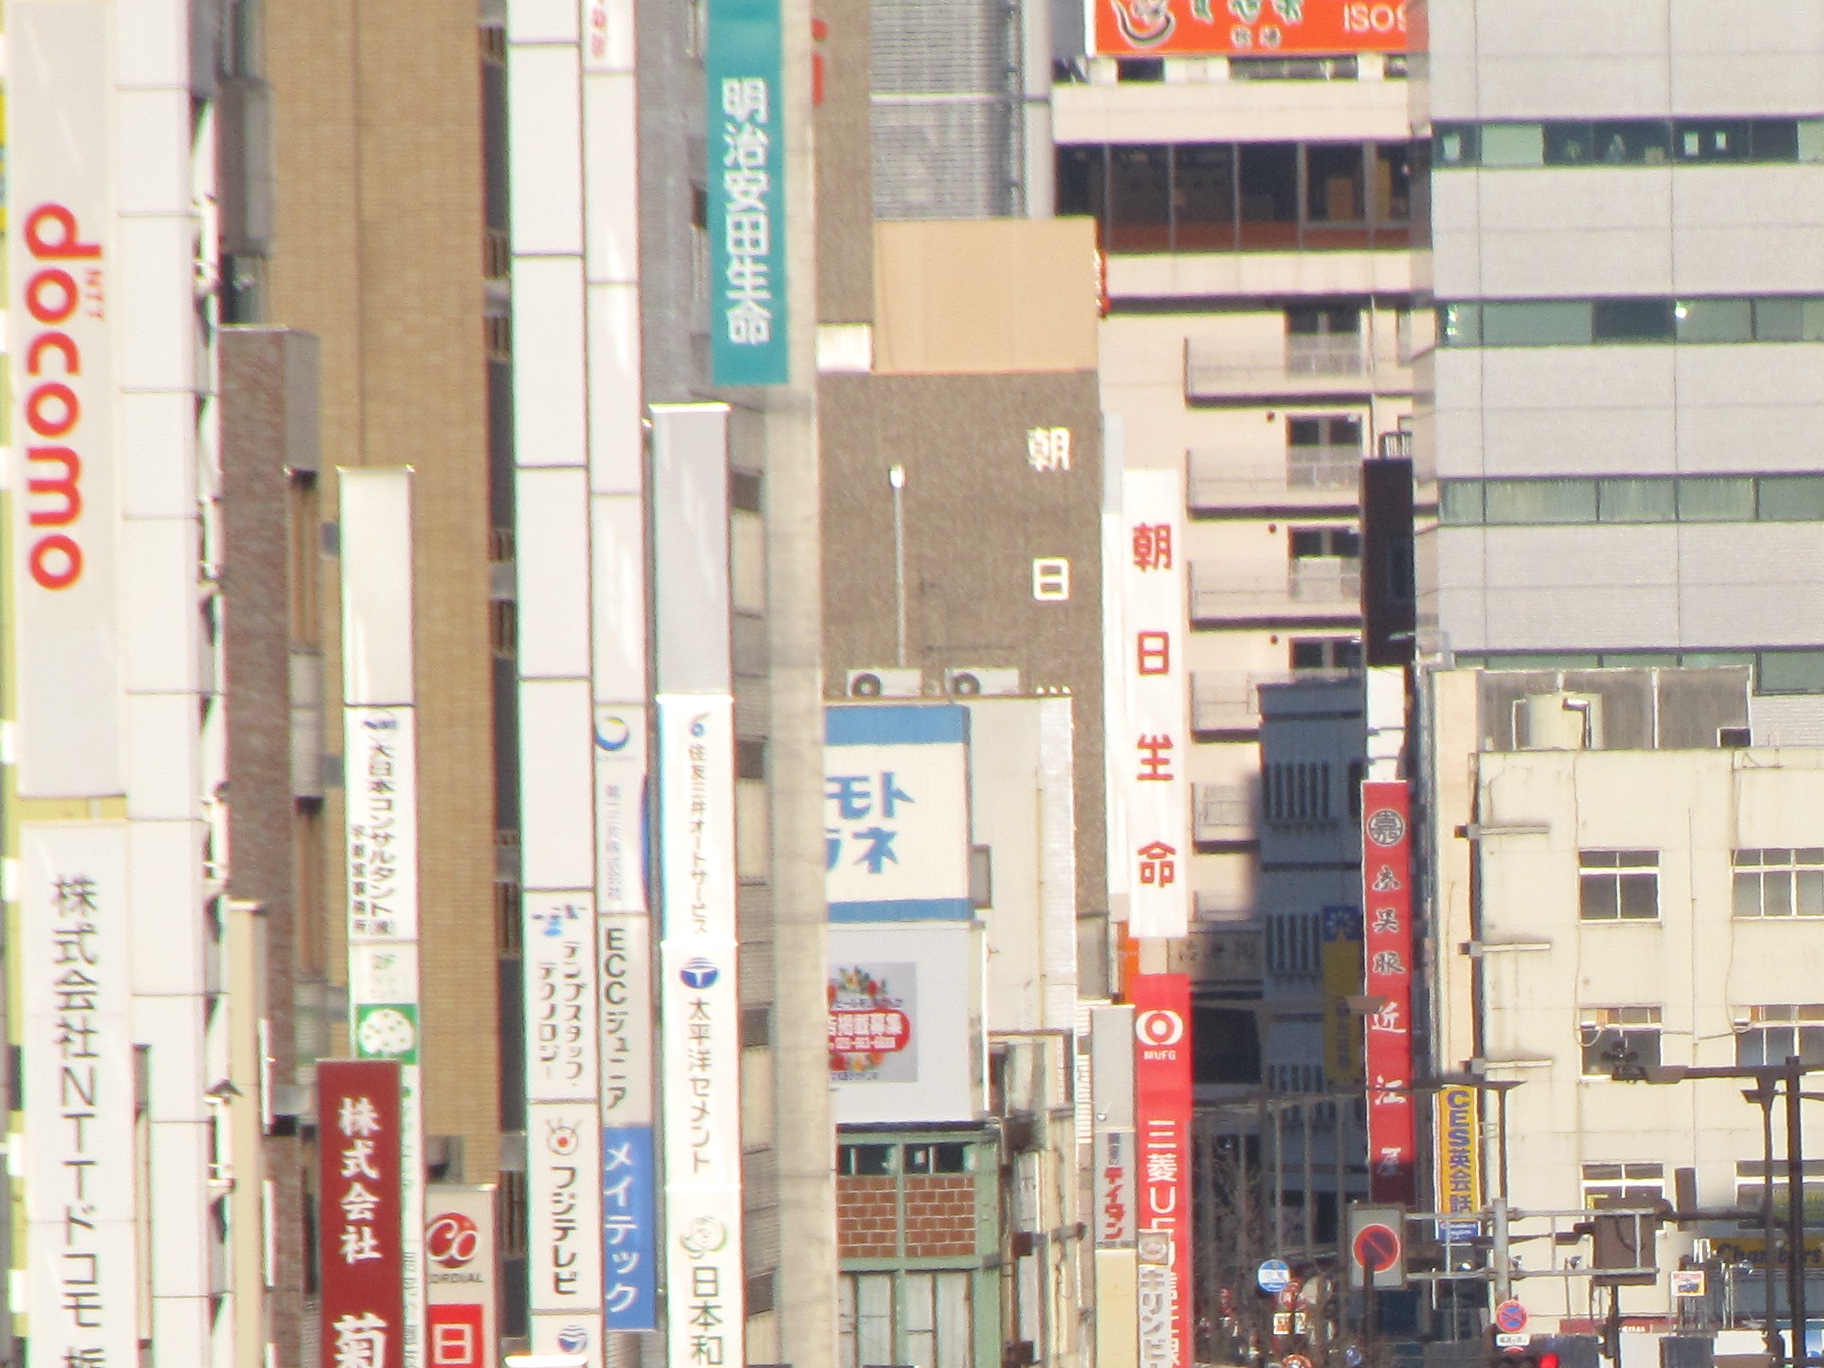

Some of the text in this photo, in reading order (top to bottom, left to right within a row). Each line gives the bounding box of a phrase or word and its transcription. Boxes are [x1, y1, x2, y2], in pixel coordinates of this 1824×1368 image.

[721, 77, 773, 346] 明治安田生命
[24, 204, 103, 591] docomo
[1027, 427, 1071, 601] 朝日
[1132, 523, 1176, 888] 朝日生命
[604, 927, 629, 1111] ECCジュニア
[688, 997, 712, 1173] 太平洋セメント
[1143, 1049, 1176, 1061] MUFG
[337, 1096, 382, 1265] 株式会社
[550, 1165, 578, 1296] フジテレビ
[602, 1142, 639, 1313] メイテック
